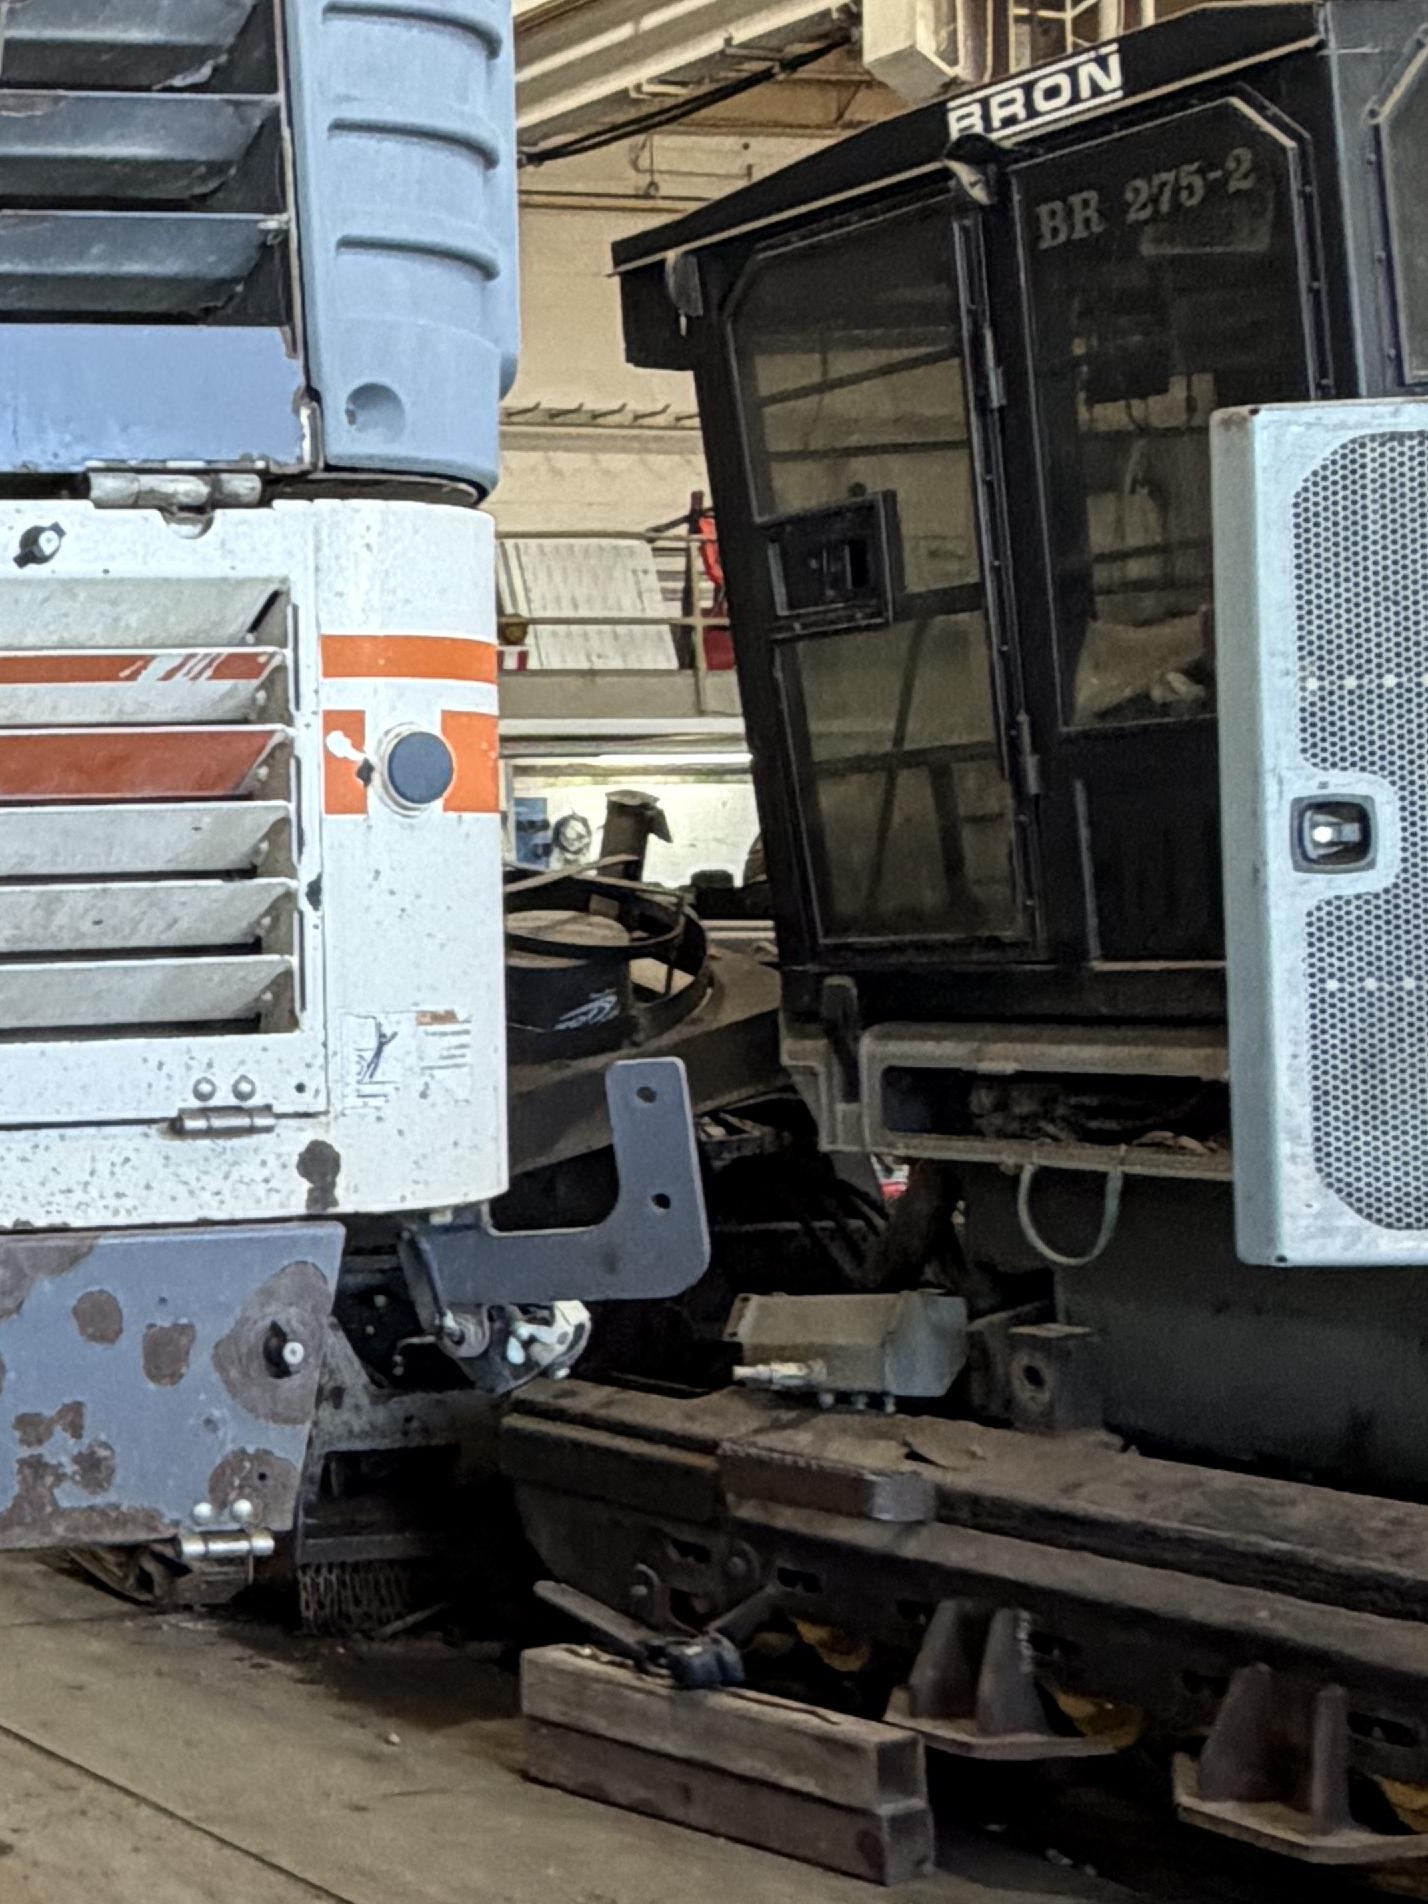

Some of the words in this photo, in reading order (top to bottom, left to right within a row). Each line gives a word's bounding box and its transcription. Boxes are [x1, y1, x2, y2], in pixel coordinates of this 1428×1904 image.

[947, 53, 1123, 142] BRON
[1036, 190, 1105, 249] BR
[1125, 147, 1255, 225] 275-2
